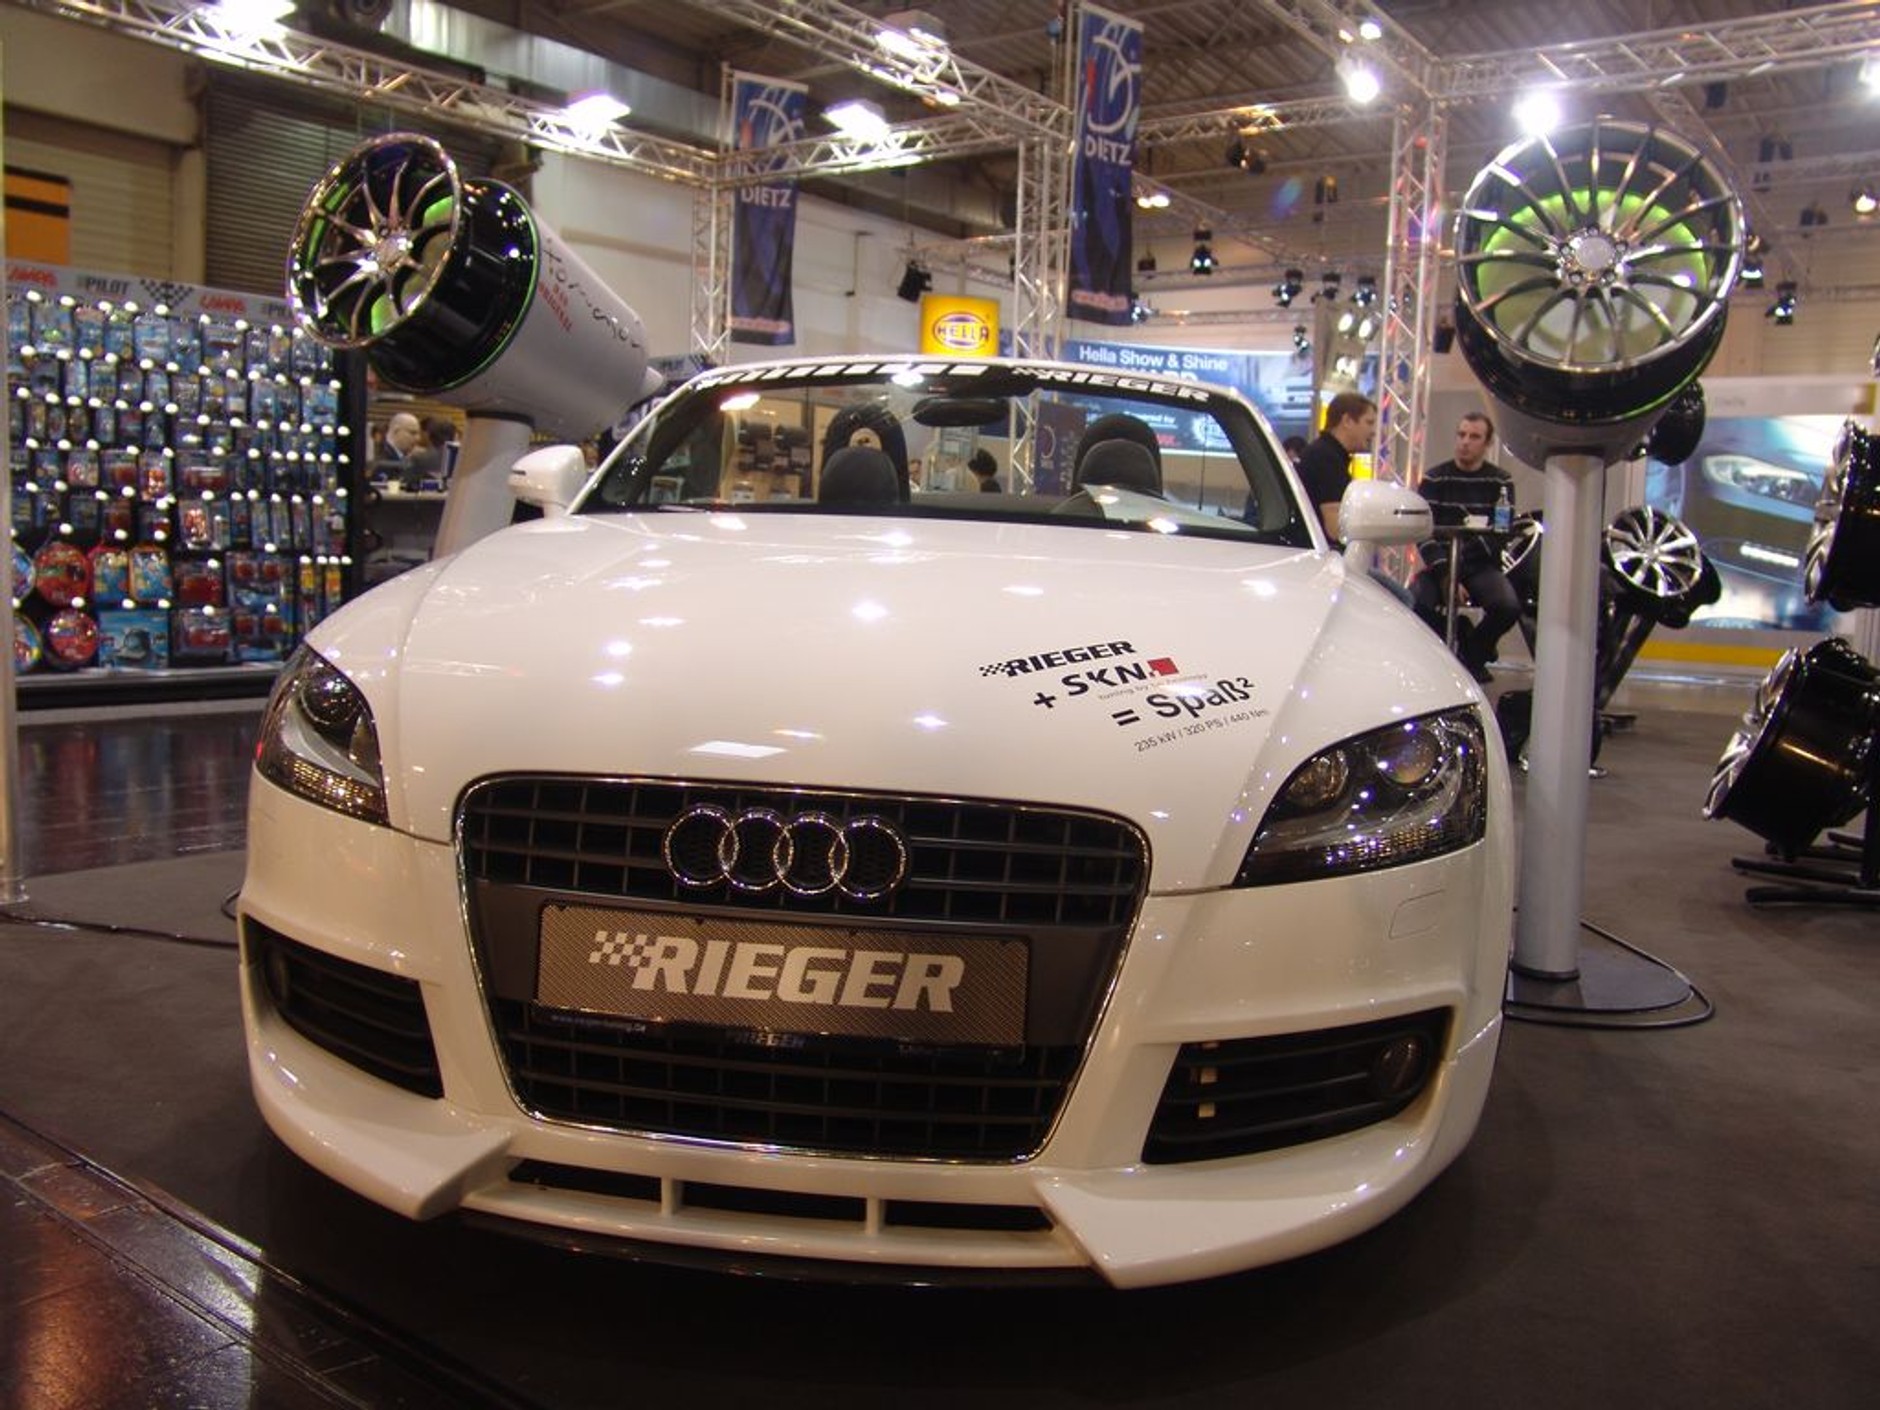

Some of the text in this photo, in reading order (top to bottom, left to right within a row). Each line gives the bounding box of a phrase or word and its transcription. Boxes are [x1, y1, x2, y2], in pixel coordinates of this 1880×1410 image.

[1085, 135, 1132, 165] DIETZ
[741, 187, 793, 208] DIETZ
[85, 276, 130, 295] PILOT
[937, 324, 990, 342] HELLA
[1079, 346, 1229, 371] Hella Show & Shine
[1041, 367, 1210, 402] RIEGER
[1005, 641, 1137, 677] RIEGER
[1034, 692, 1057, 709] +
[1111, 709, 1141, 727] =
[1146, 677, 1255, 719] Spaß²
[1134, 737, 1158, 752] 235
[1159, 730, 1177, 744] kW
[1183, 722, 1206, 736] 320
[1205, 718, 1224, 731] PS
[632, 935, 965, 1013] RIEGER
